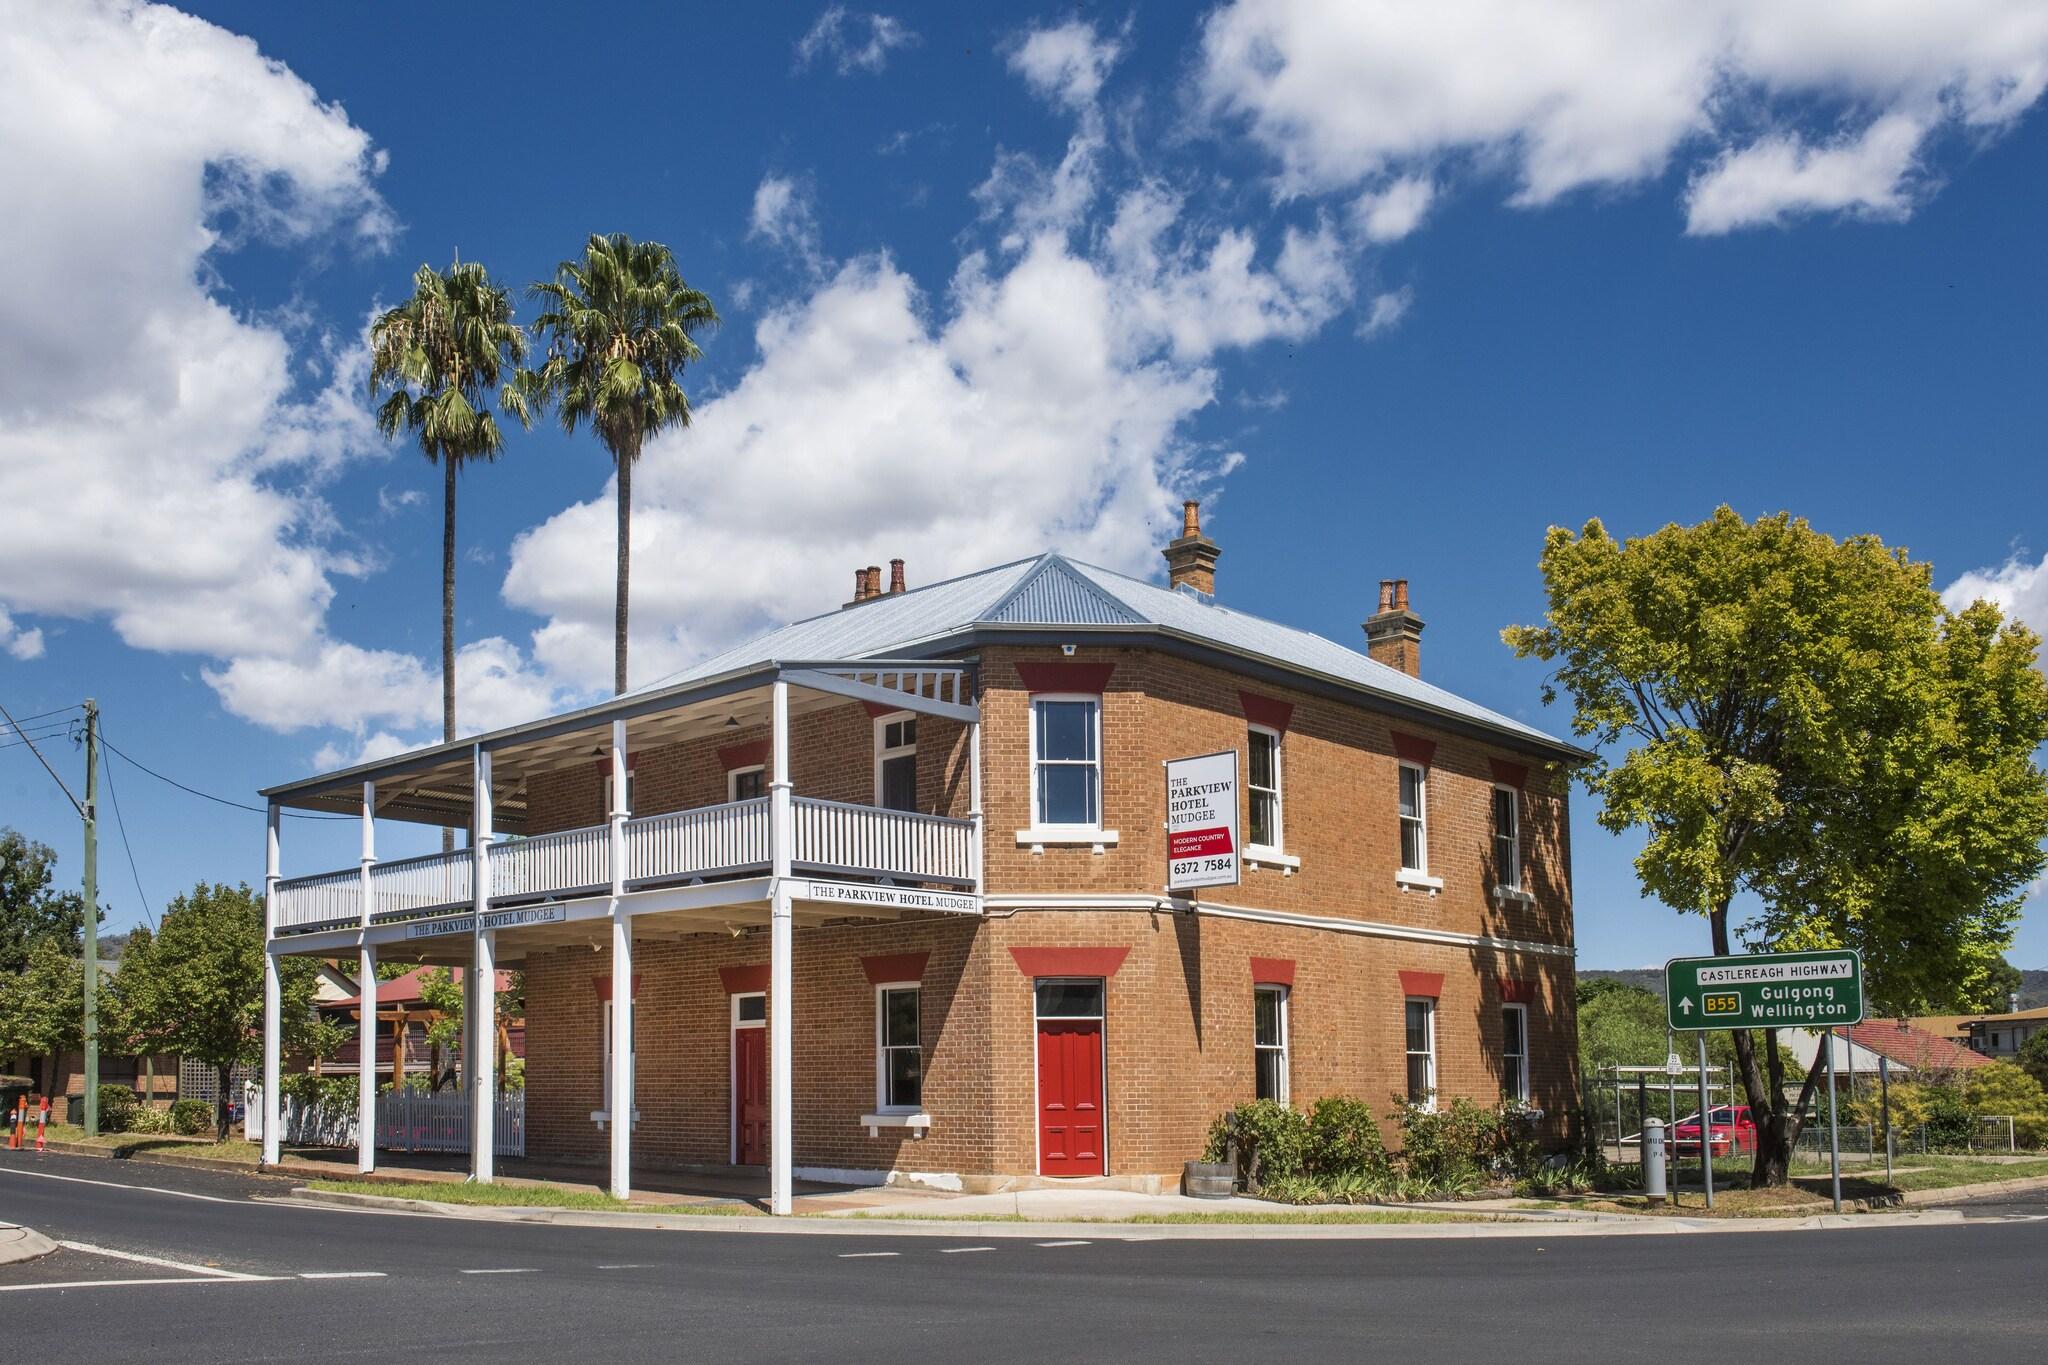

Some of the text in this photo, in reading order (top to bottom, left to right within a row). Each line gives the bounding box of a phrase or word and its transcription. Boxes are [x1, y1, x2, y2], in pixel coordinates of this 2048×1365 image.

[1171, 778, 1188, 787] THE
[1171, 781, 1232, 799] PARKVIEW
[1171, 798, 1209, 811] HOTEL
[1171, 810, 1216, 824] MUDGEE
[1198, 834, 1225, 842] COUNTRY
[1173, 844, 1202, 853] ELEGANCE
[1174, 858, 1232, 874] 6372 7584
[813, 886, 974, 910] THE PARKVIEW HOTEL MUDGEE
[414, 924, 430, 936] THE
[484, 912, 515, 928] HOTEL
[516, 908, 555, 923] MUDGEE
[1700, 964, 1848, 982] CASTLEREAGH HIGHWAY
[1761, 986, 1834, 1002] Gulgong
[1707, 997, 1737, 1011] B55
[1751, 1004, 1847, 1020] Wellington
